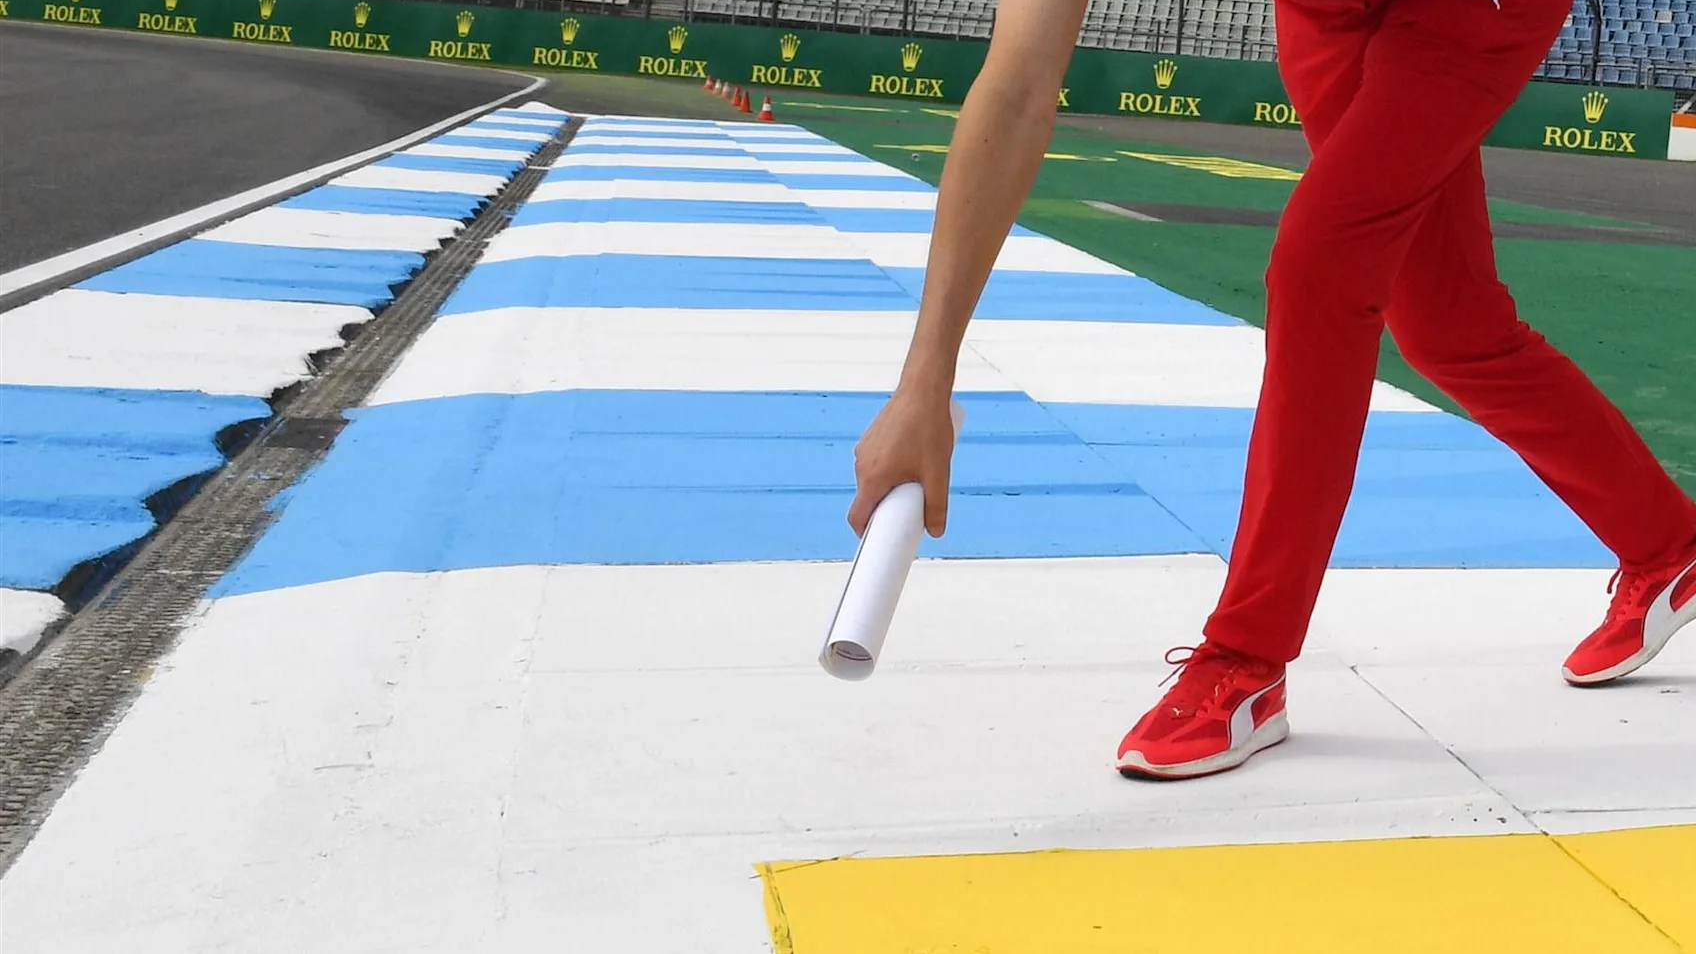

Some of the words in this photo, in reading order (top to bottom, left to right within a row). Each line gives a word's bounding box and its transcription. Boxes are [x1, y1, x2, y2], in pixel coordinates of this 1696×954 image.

[44, 5, 100, 24] ROLEX
[139, 13, 196, 33] ROLEX
[233, 22, 291, 42] ROLEX
[330, 31, 389, 51] ROLEX
[429, 41, 490, 60] ROLEX
[533, 47, 597, 69] ROLEX
[639, 56, 707, 78] ROLEX
[751, 65, 820, 87] ROLEX
[871, 75, 942, 97] ROLEX
[1120, 92, 1199, 116] ROLEX
[1255, 102, 1300, 125] ROL
[1544, 126, 1634, 153] ROLEX
